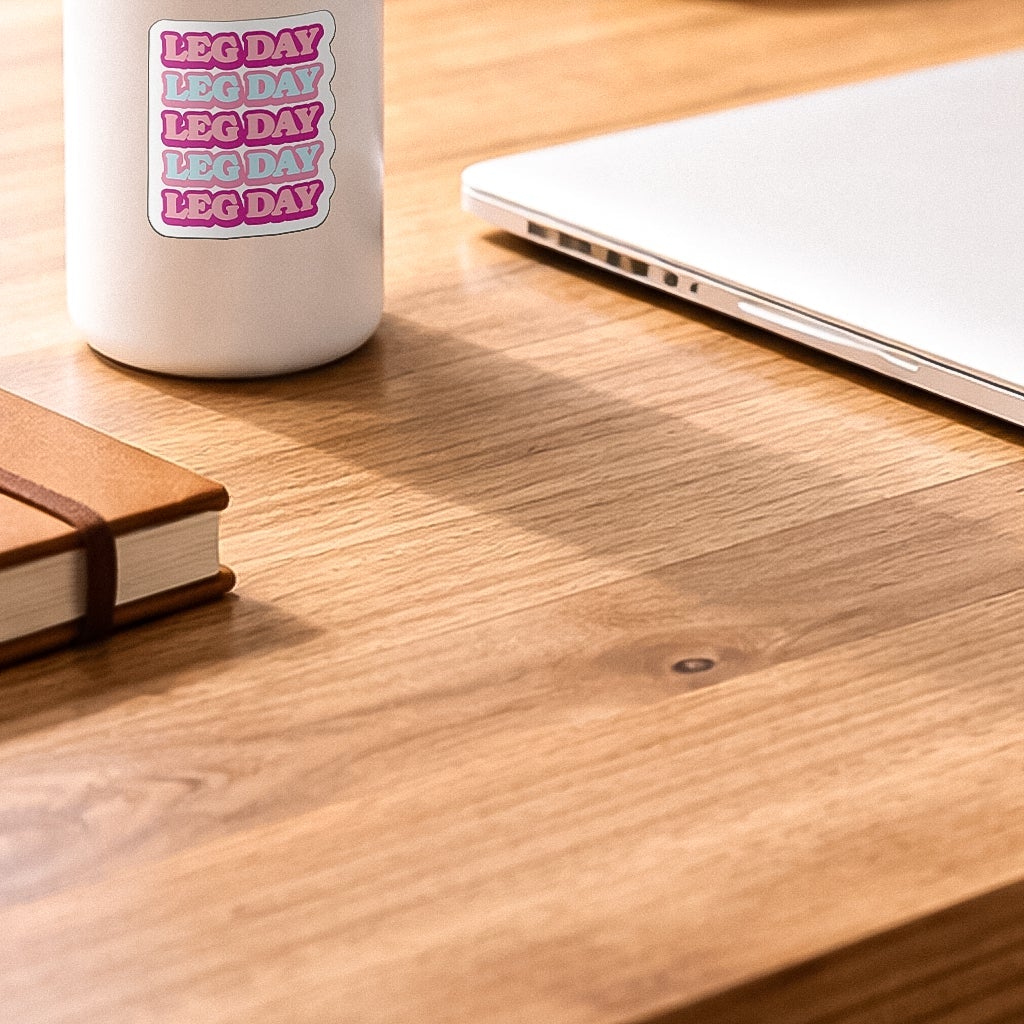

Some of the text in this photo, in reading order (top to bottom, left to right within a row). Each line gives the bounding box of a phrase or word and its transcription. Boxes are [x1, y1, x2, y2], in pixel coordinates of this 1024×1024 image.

[162, 26, 321, 65] LEG DAY
[163, 65, 321, 104] LEG DAY
[162, 104, 321, 144] LEG DAY
[163, 143, 321, 183] LEG DAY
[162, 182, 321, 223] LEG DAY
